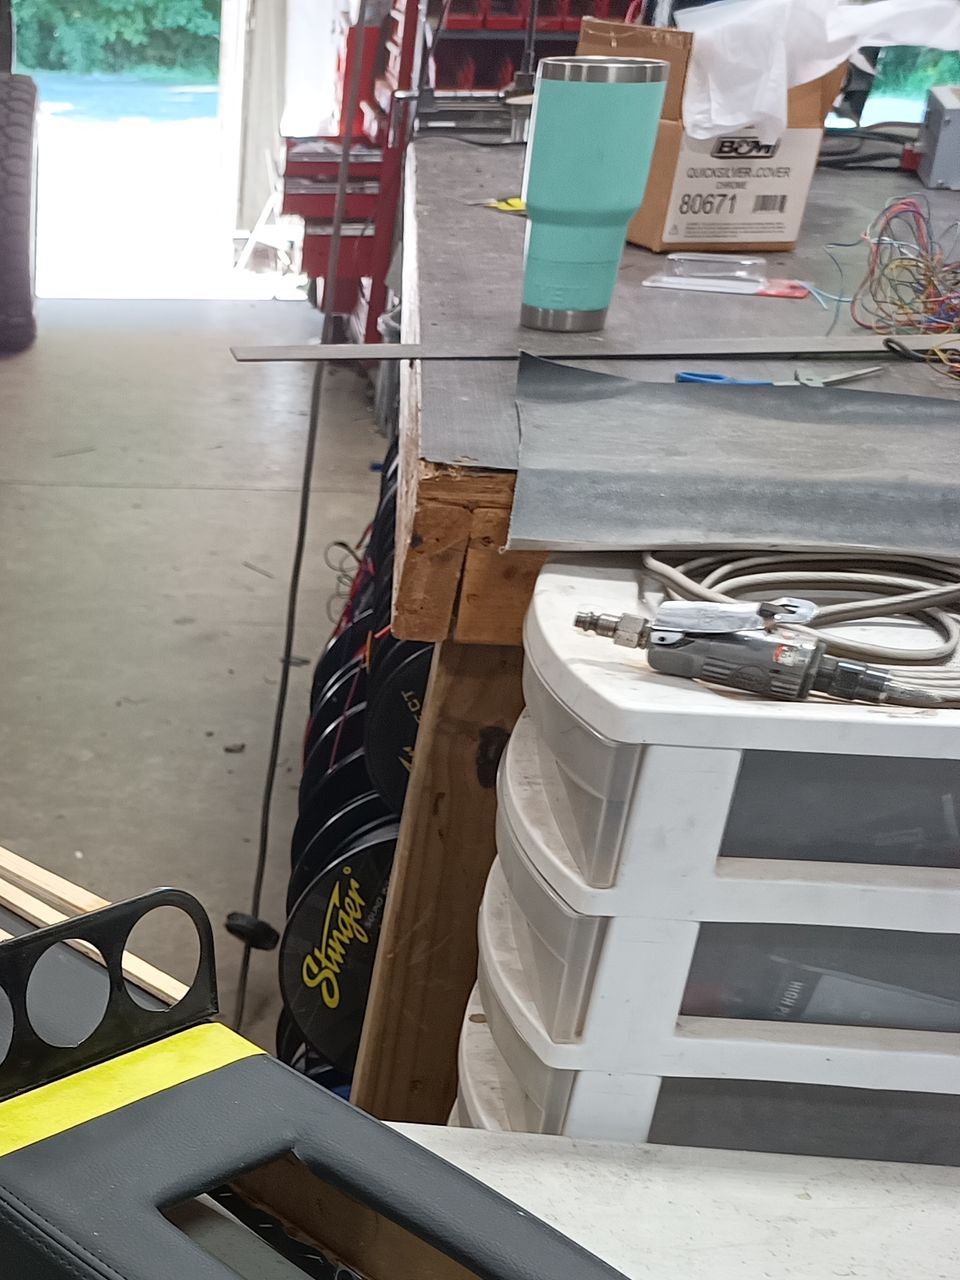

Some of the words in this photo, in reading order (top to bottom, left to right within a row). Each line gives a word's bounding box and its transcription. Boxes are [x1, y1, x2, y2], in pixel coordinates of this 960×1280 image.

[715, 181, 747, 190] CHROME
[679, 193, 737, 215] 80671
[780, 980, 805, 1007] HIGH
